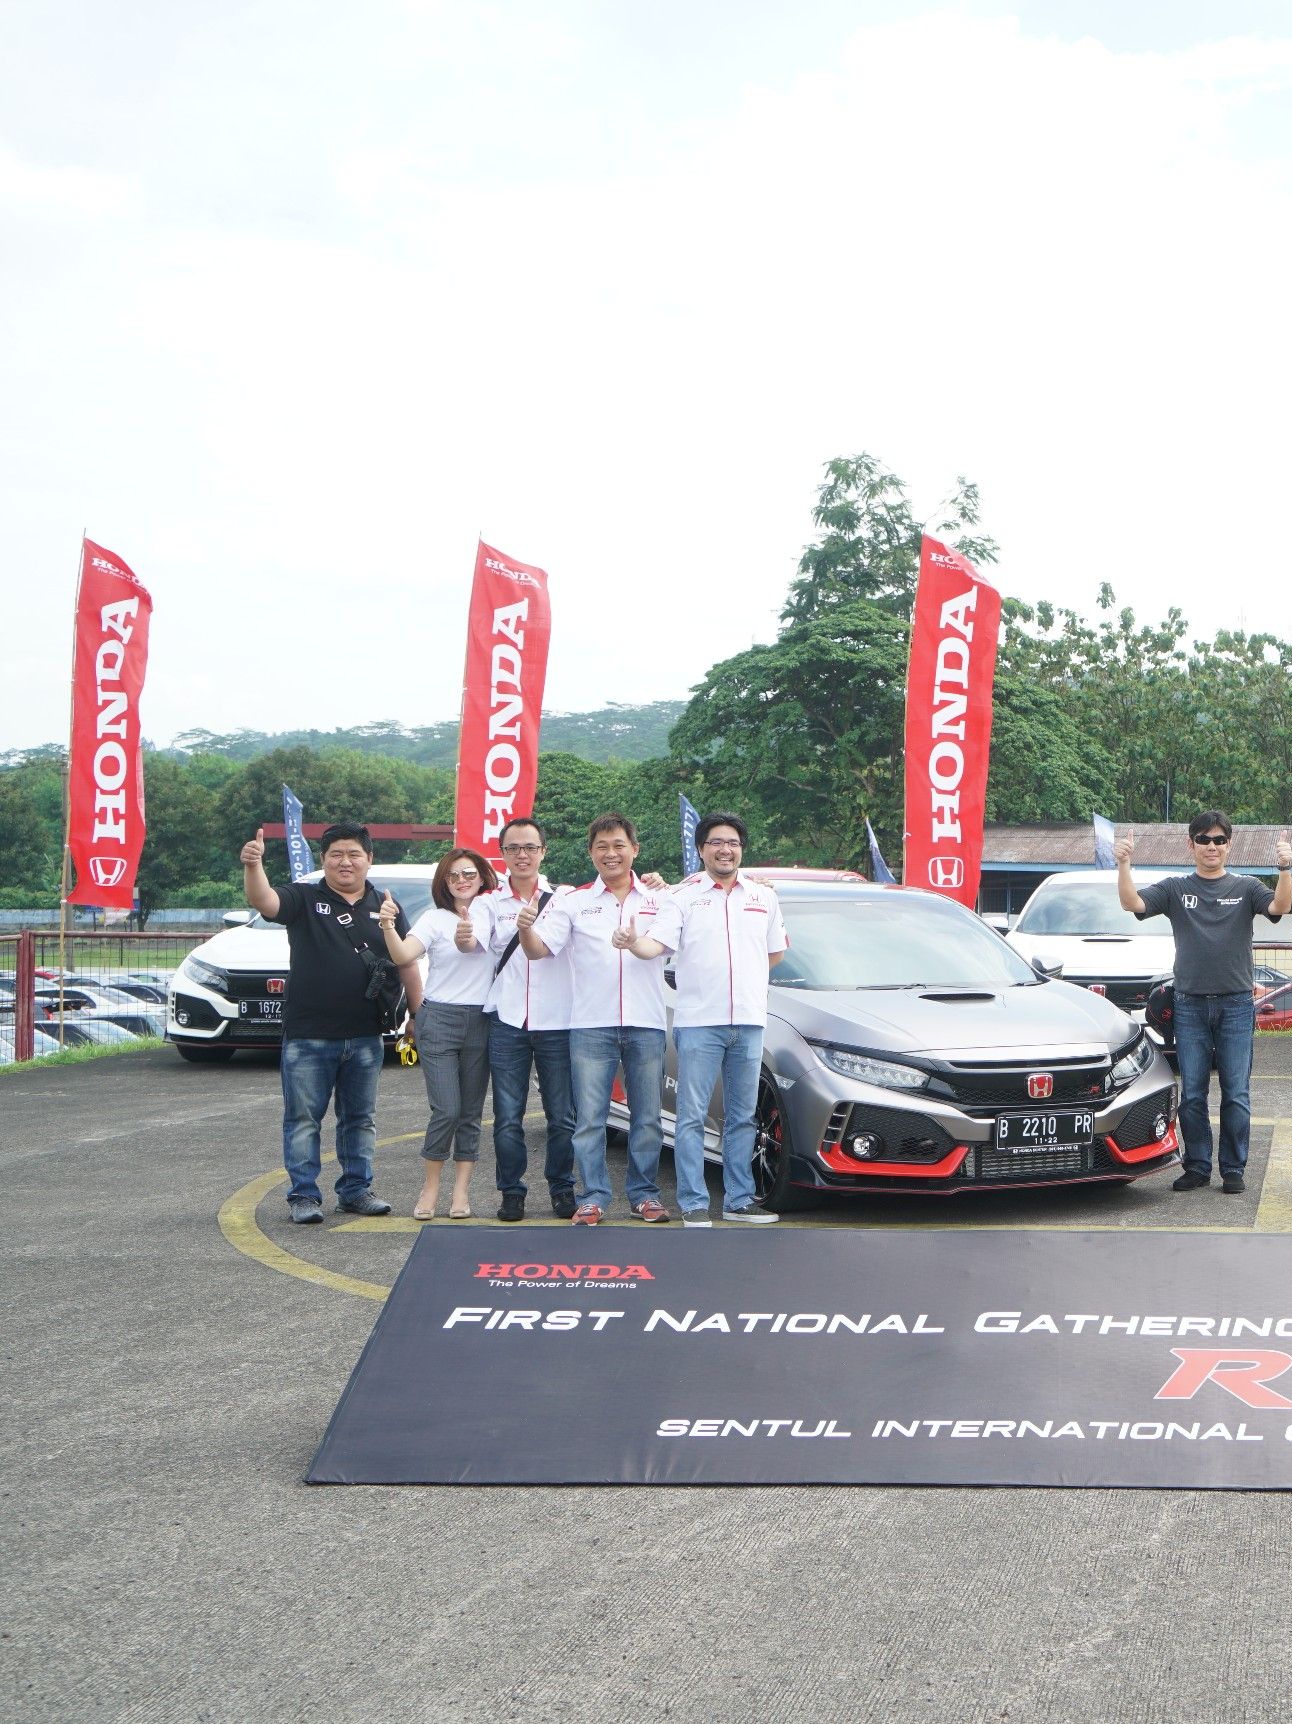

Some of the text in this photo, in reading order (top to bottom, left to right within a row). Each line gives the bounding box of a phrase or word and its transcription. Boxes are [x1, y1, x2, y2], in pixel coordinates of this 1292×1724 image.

[92, 596, 139, 845] HONDA
[483, 597, 528, 844] HONDA
[928, 585, 978, 844] HONDA
[241, 1001, 282, 1014] B 1672
[999, 1115, 1091, 1138] B 2210 PR
[474, 1263, 656, 1280] HONDA
[488, 1279, 514, 1287] The
[517, 1280, 561, 1288] Power
[584, 1281, 637, 1289] Dreams
[442, 1307, 625, 1331] FIRST
[643, 1309, 945, 1334] NATIONAL
[656, 1419, 852, 1438] SENTUL
[871, 1420, 1264, 1441] INTERNATIONAL
